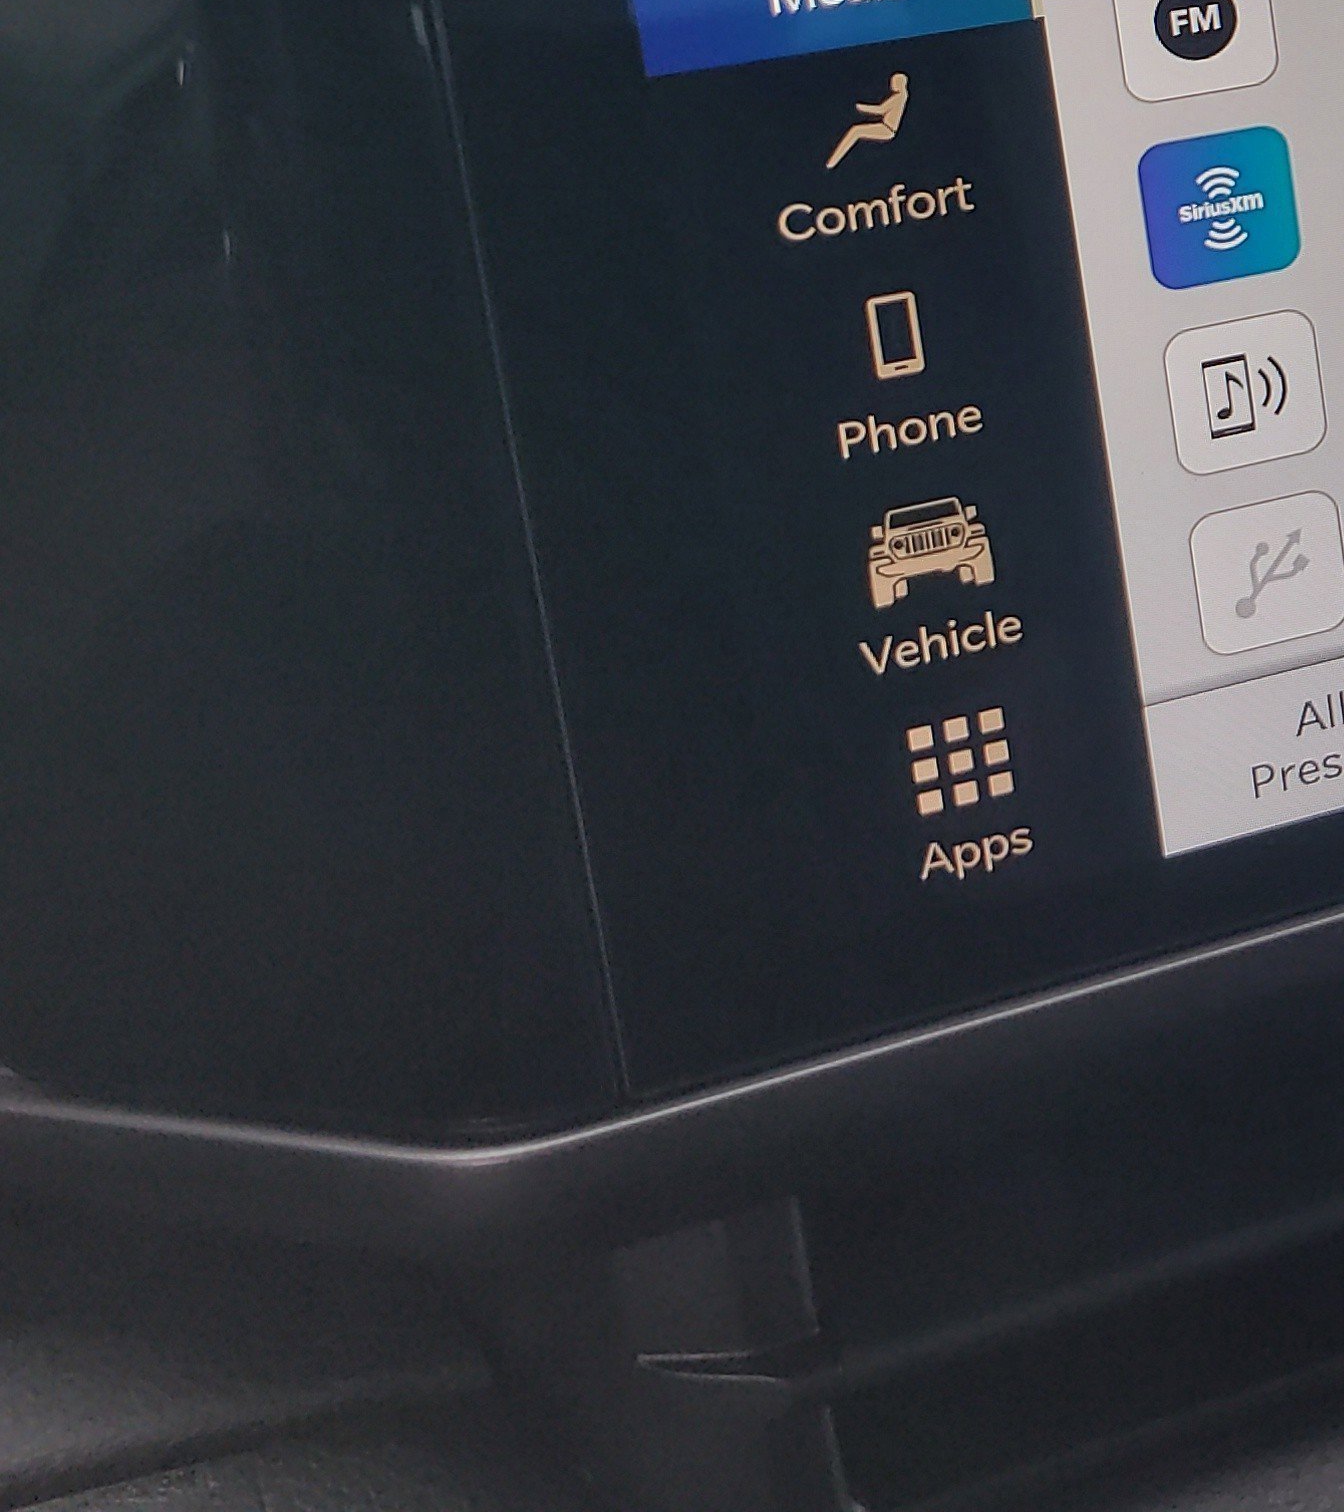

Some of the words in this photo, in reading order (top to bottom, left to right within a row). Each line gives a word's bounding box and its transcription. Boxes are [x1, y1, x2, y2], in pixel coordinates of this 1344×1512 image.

[1168, 4, 1222, 36] FM
[777, 176, 975, 242] Comfort
[837, 402, 984, 460] Phone
[858, 611, 1024, 676] Vehicle
[919, 826, 1034, 881] Apps
